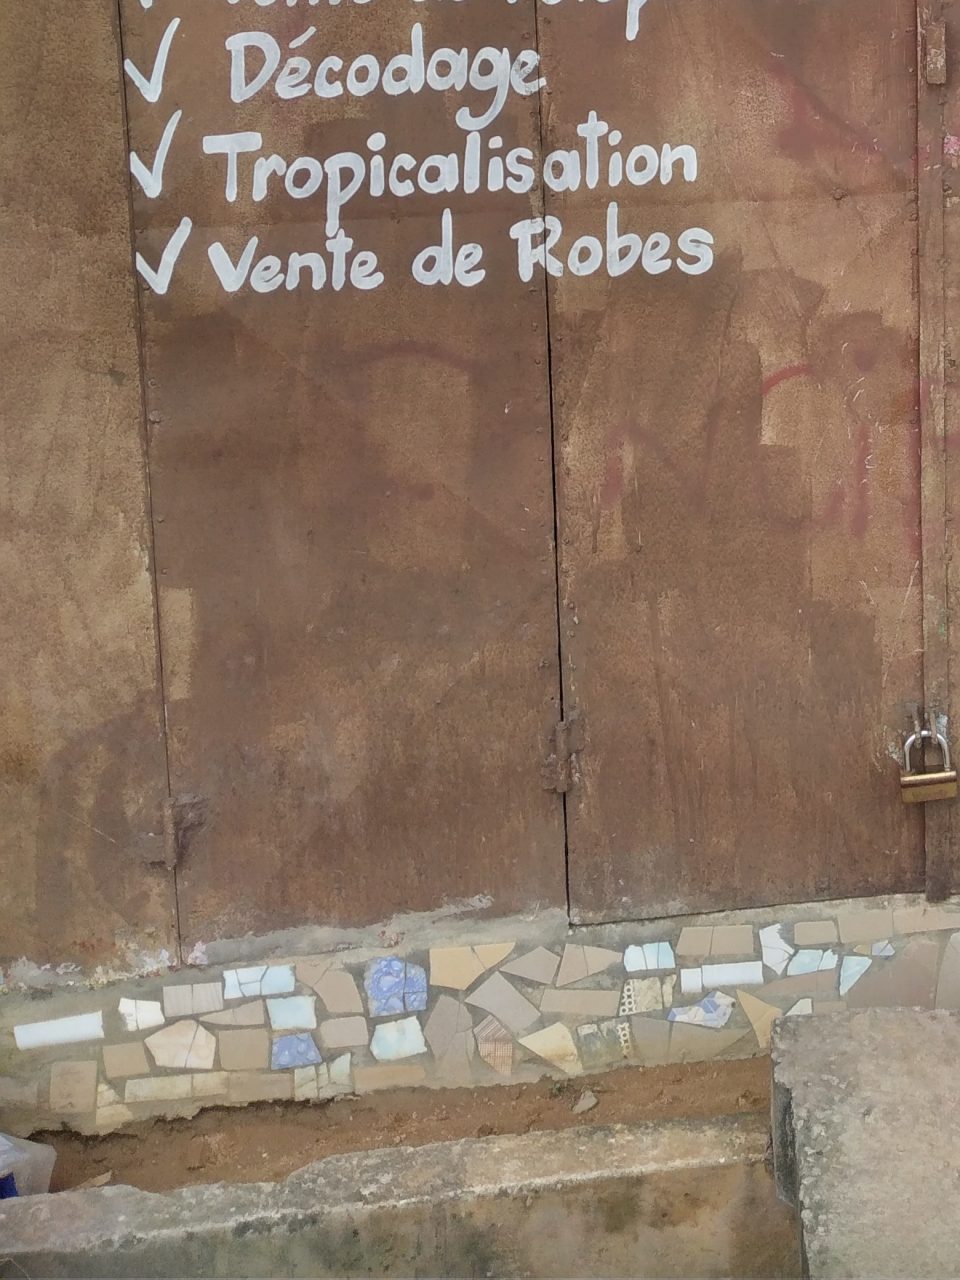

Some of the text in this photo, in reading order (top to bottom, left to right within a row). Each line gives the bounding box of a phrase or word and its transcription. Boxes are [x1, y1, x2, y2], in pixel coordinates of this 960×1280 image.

[224, 24, 546, 129] Décodage
[202, 110, 698, 235] Tropicalisation
[207, 201, 715, 293] Vente de Robes
